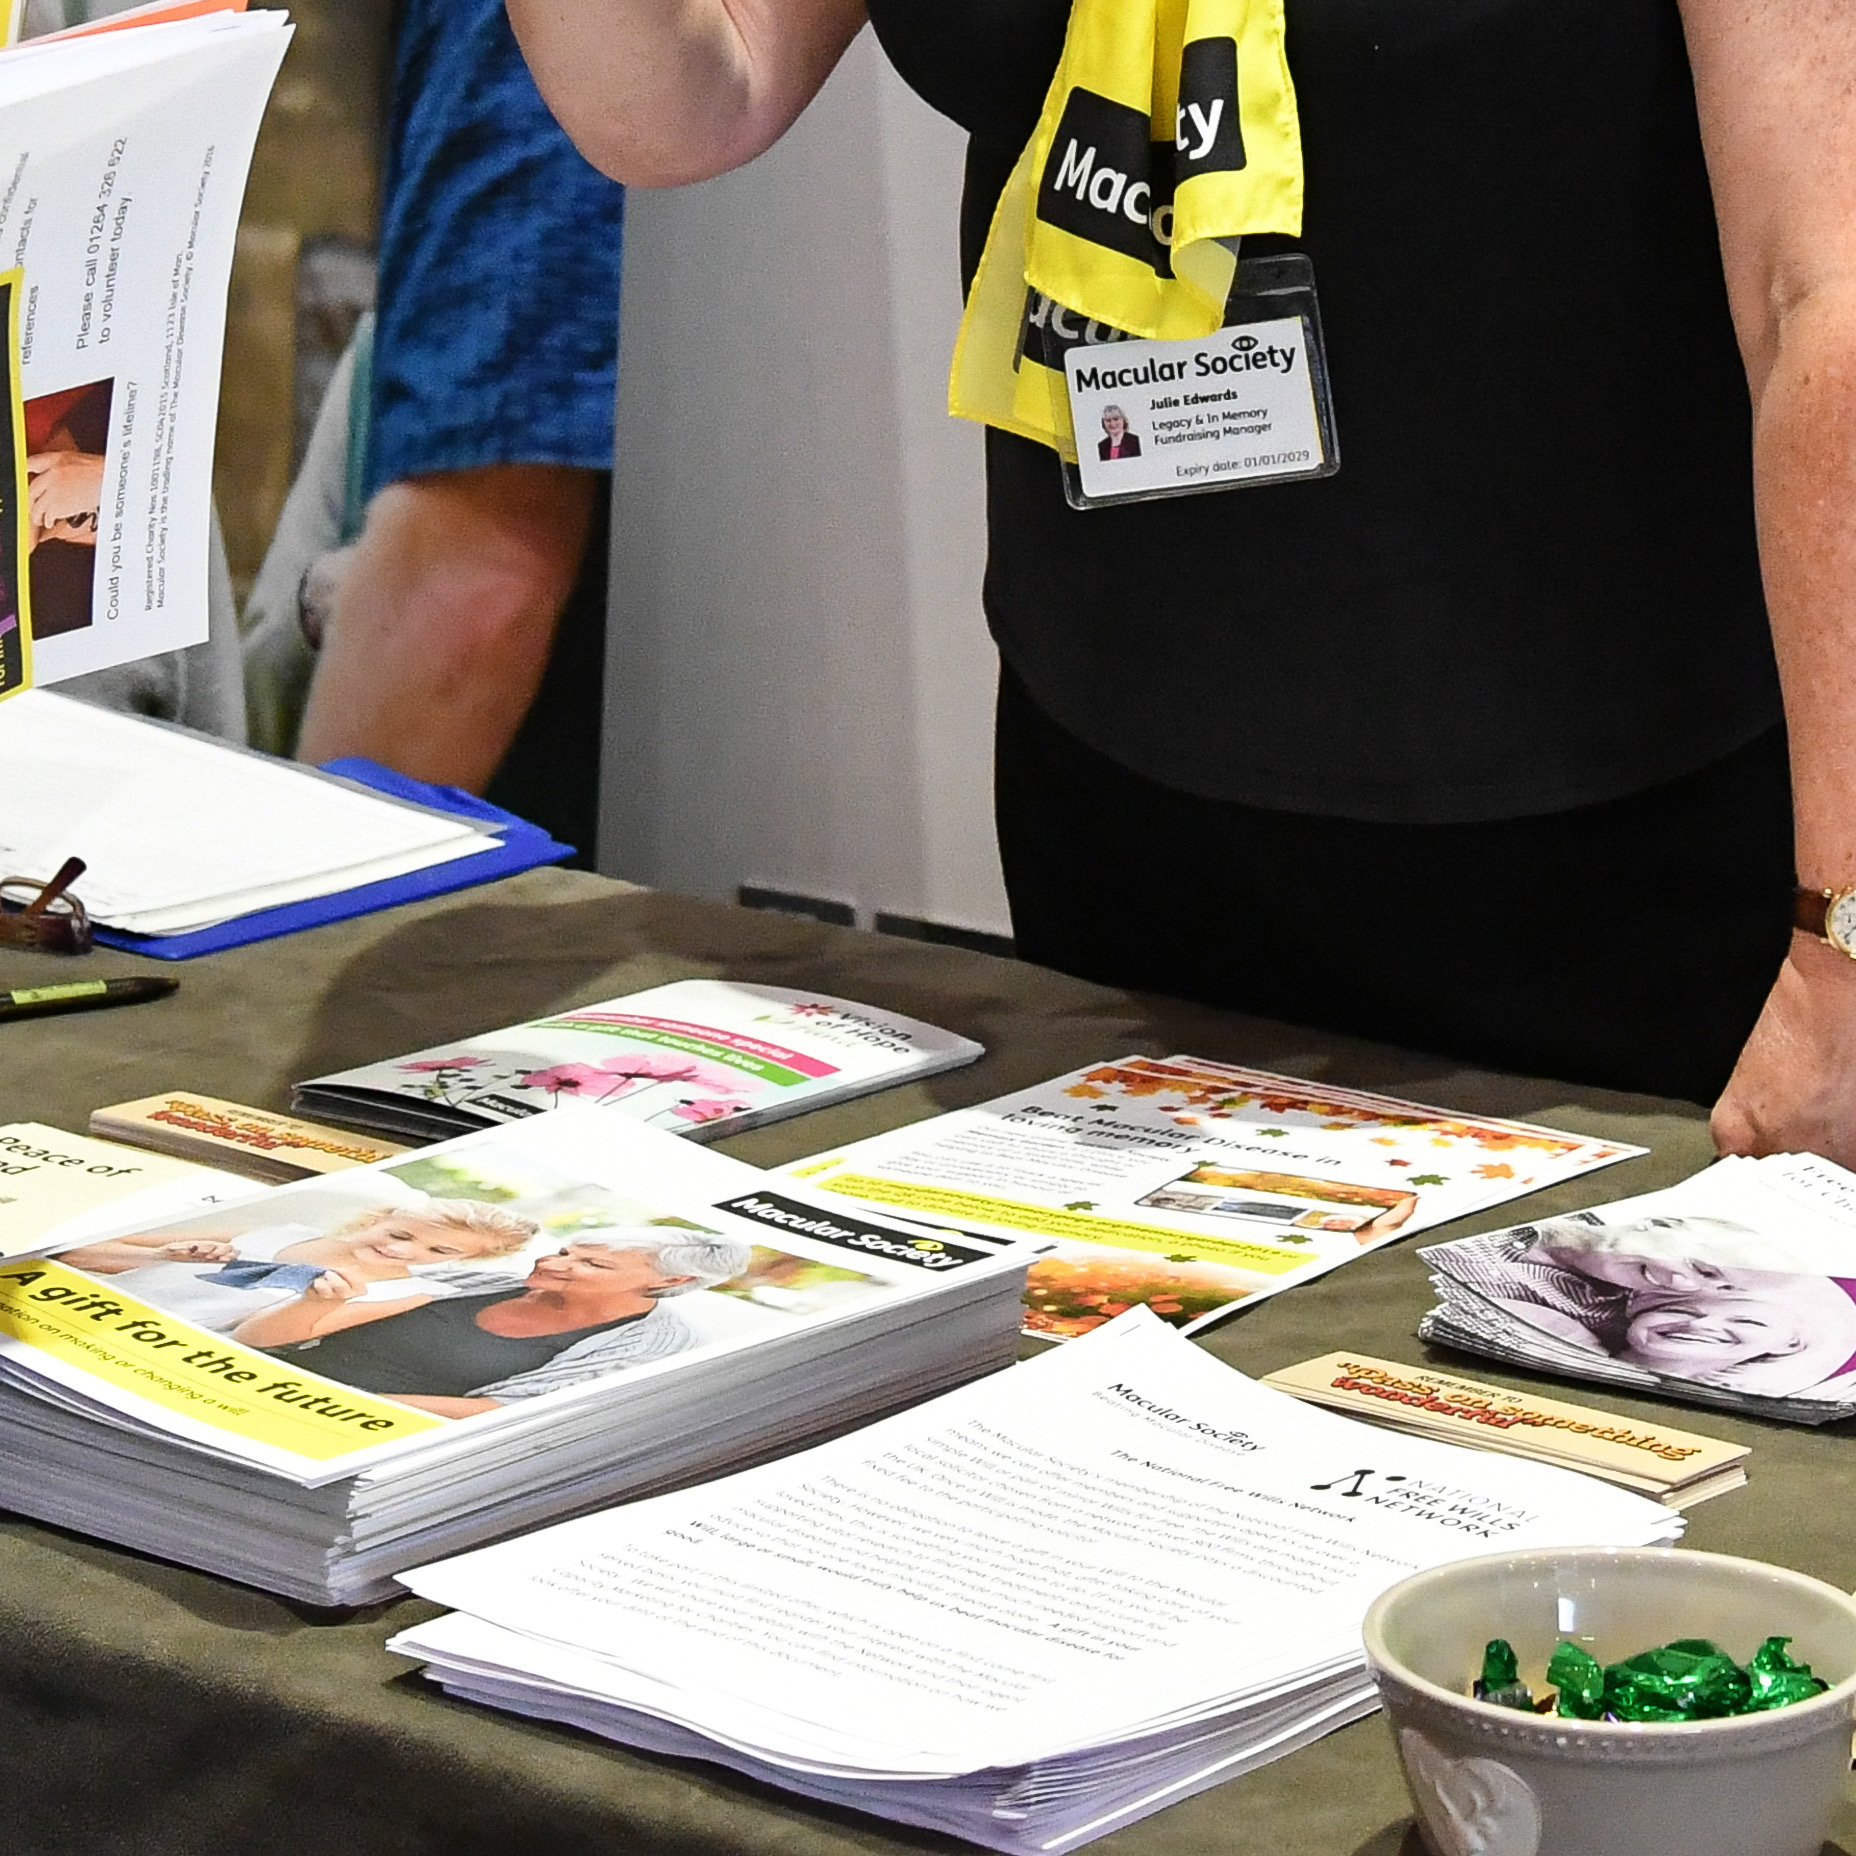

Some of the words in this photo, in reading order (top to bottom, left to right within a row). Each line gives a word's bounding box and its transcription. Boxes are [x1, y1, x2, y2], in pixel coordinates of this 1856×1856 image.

[106, 135, 128, 168] 622
[97, 169, 117, 200] 326
[86, 202, 109, 255] 01264
[83, 256, 98, 287] call
[100, 245, 120, 323] volunteer
[75, 290, 94, 350] Please
[97, 325, 112, 345] to
[1075, 357, 1188, 394] Macular
[1193, 344, 1296, 377] Society
[121, 379, 138, 437] lifeline?
[1148, 395, 1181, 411] Julie
[1182, 387, 1239, 407] Edwards
[1150, 417, 1193, 433] Legacy
[1194, 413, 1204, 426] &
[1205, 412, 1220, 424] In
[1220, 408, 1268, 421] Memory
[1153, 427, 1221, 446] Fundraising
[1222, 422, 1273, 437] Manager
[114, 438, 132, 519] someone's
[1175, 464, 1210, 478] Expiry
[1211, 459, 1242, 473] date:
[1242, 448, 1310, 469] 01/01/2029
[109, 521, 123, 542] be
[110, 543, 124, 573] you
[105, 574, 120, 621] Could
[839, 1012, 913, 1041] Vision
[1001, 1112, 1084, 1136] loving
[1086, 1128, 1204, 1157] memory
[1019, 1104, 1087, 1122] Beat
[1089, 1115, 1202, 1144] Macular
[1203, 1133, 1310, 1161] Disease
[1317, 1153, 1343, 1166] in
[85, 1164, 143, 1178] of
[732, 1198, 856, 1240] Macular
[847, 1234, 963, 1267] Society
[0, 1270, 36, 1288] A
[28, 1284, 124, 1322] gift
[115, 1319, 189, 1351] for
[182, 1348, 260, 1385] the
[256, 1380, 396, 1433] future
[37, 1323, 63, 1338] on
[58, 1332, 117, 1362] making
[113, 1359, 135, 1368] or
[132, 1367, 204, 1400] changing
[201, 1397, 217, 1405] a
[215, 1402, 250, 1416] will
[1107, 1383, 1190, 1425] Macular
[1189, 1419, 1266, 1452] Society
[1110, 1449, 1133, 1463] The
[1139, 1460, 1207, 1485] National
[1208, 1481, 1244, 1494] Free
[1248, 1491, 1287, 1506] Wills
[1289, 1501, 1359, 1523] Network
[1406, 1479, 1539, 1522] NATIONAL
[1364, 1495, 1502, 1539] NETWORK
[1386, 1487, 1448, 1506] FREE
[1448, 1503, 1522, 1532] WILLS
